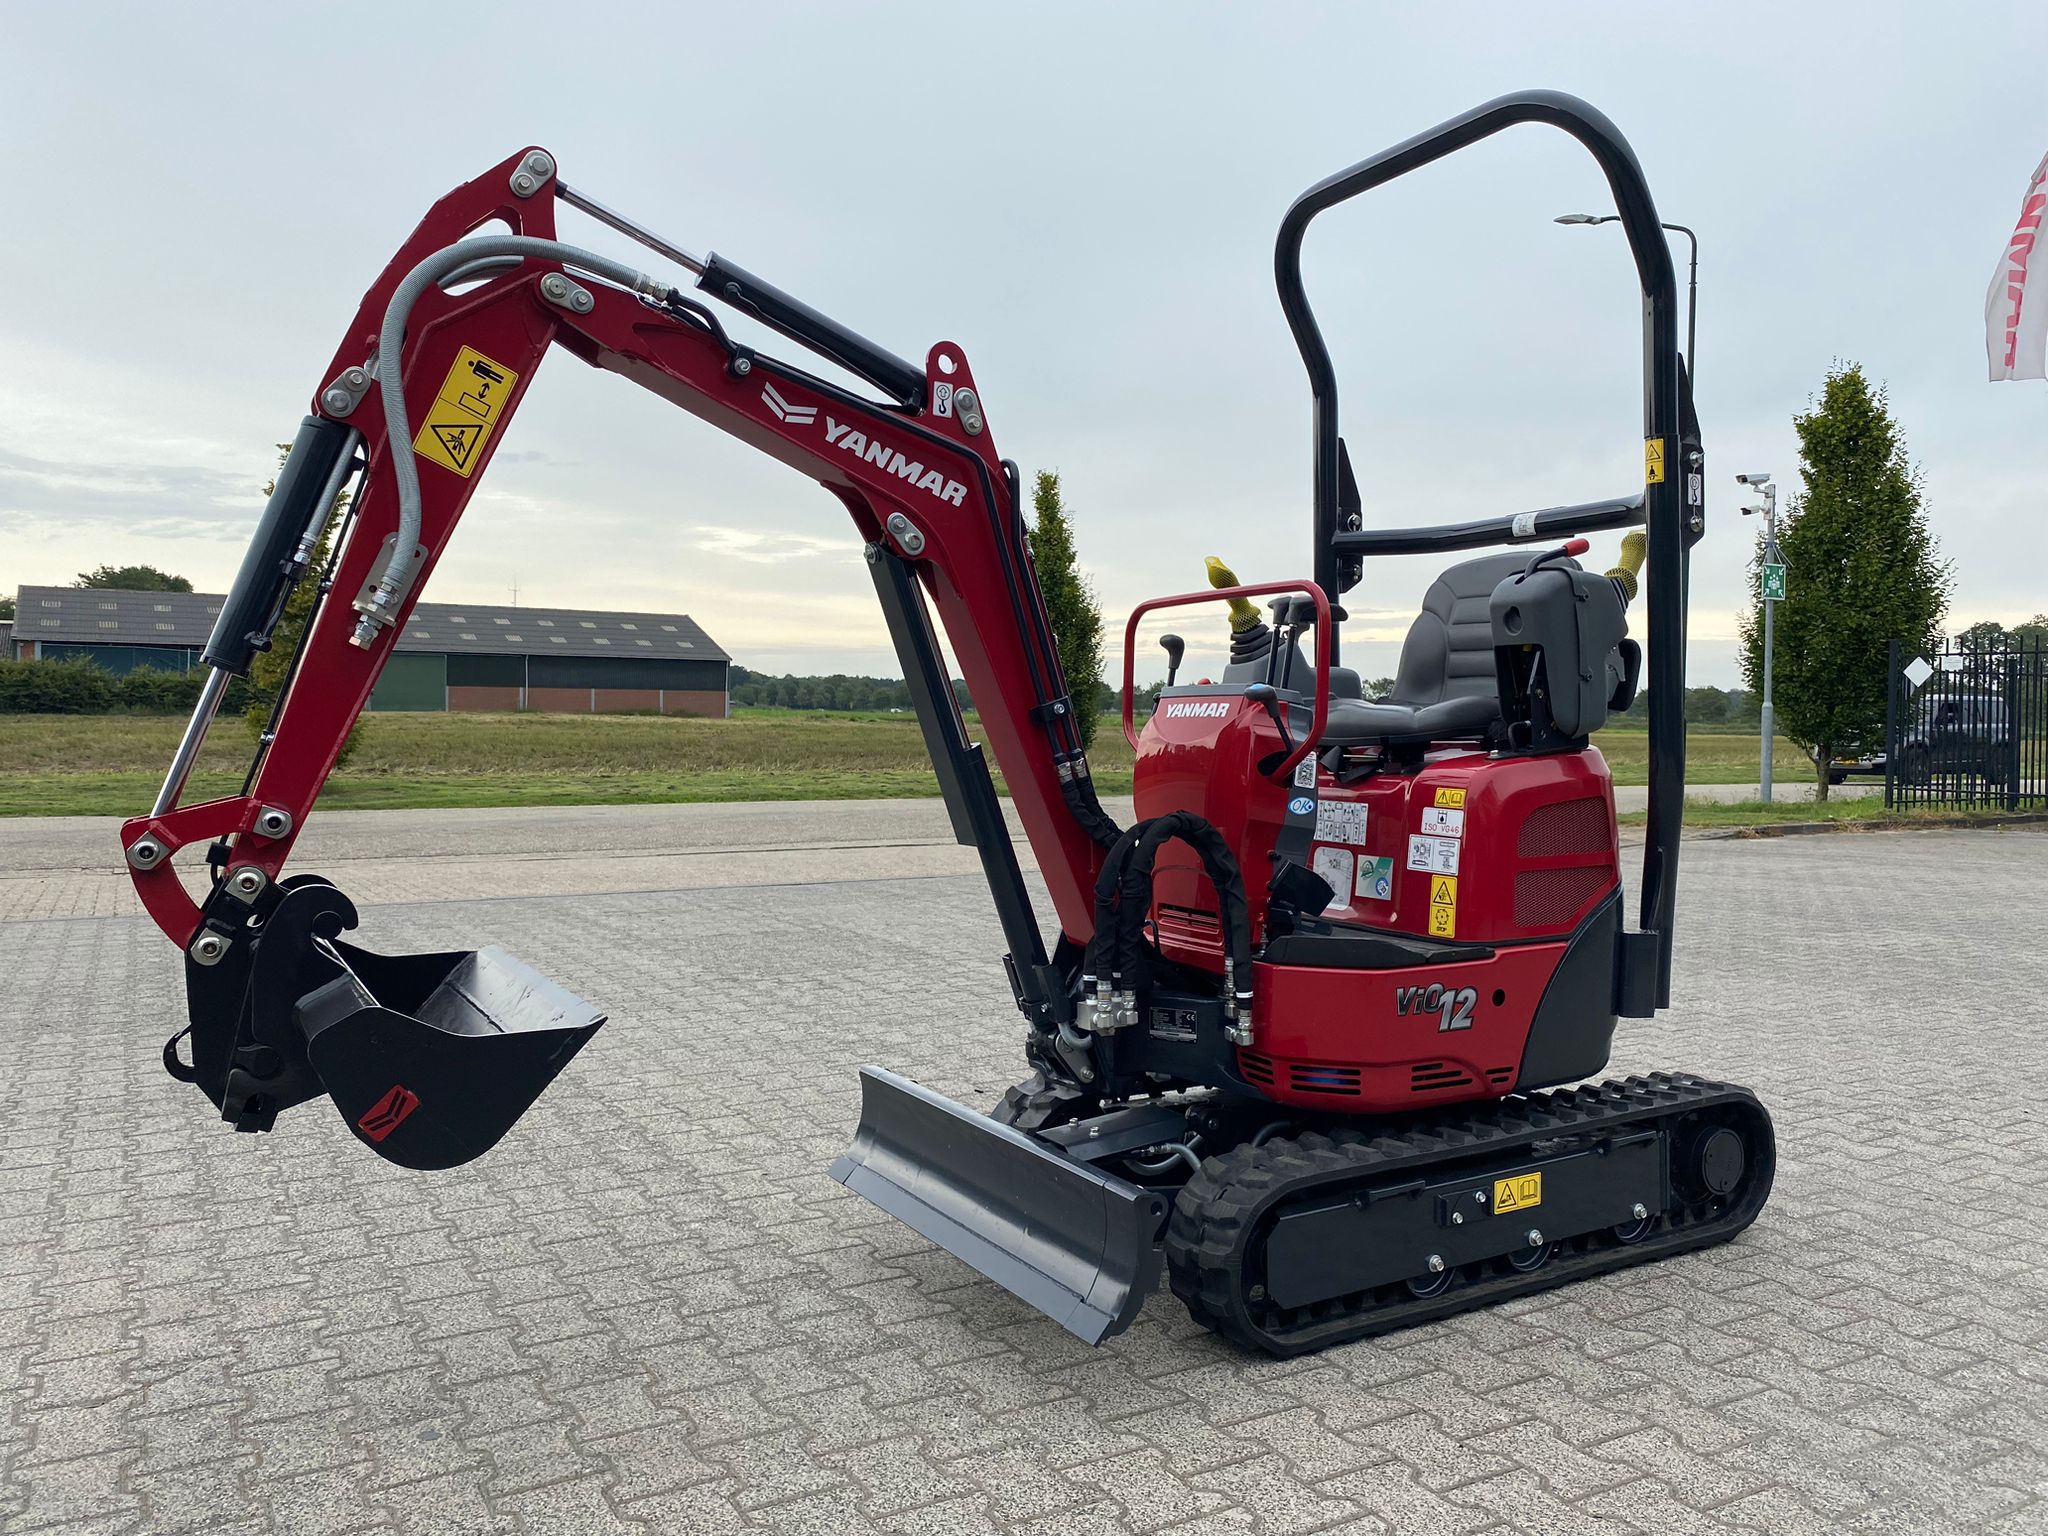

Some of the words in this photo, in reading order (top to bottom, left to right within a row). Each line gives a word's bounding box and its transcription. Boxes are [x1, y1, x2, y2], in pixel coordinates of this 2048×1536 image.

[825, 416, 968, 507] YANMAR
[1166, 702, 1230, 718] YANMAR
[1424, 822, 1437, 831] ISO
[1441, 825, 1460, 834] VG46
